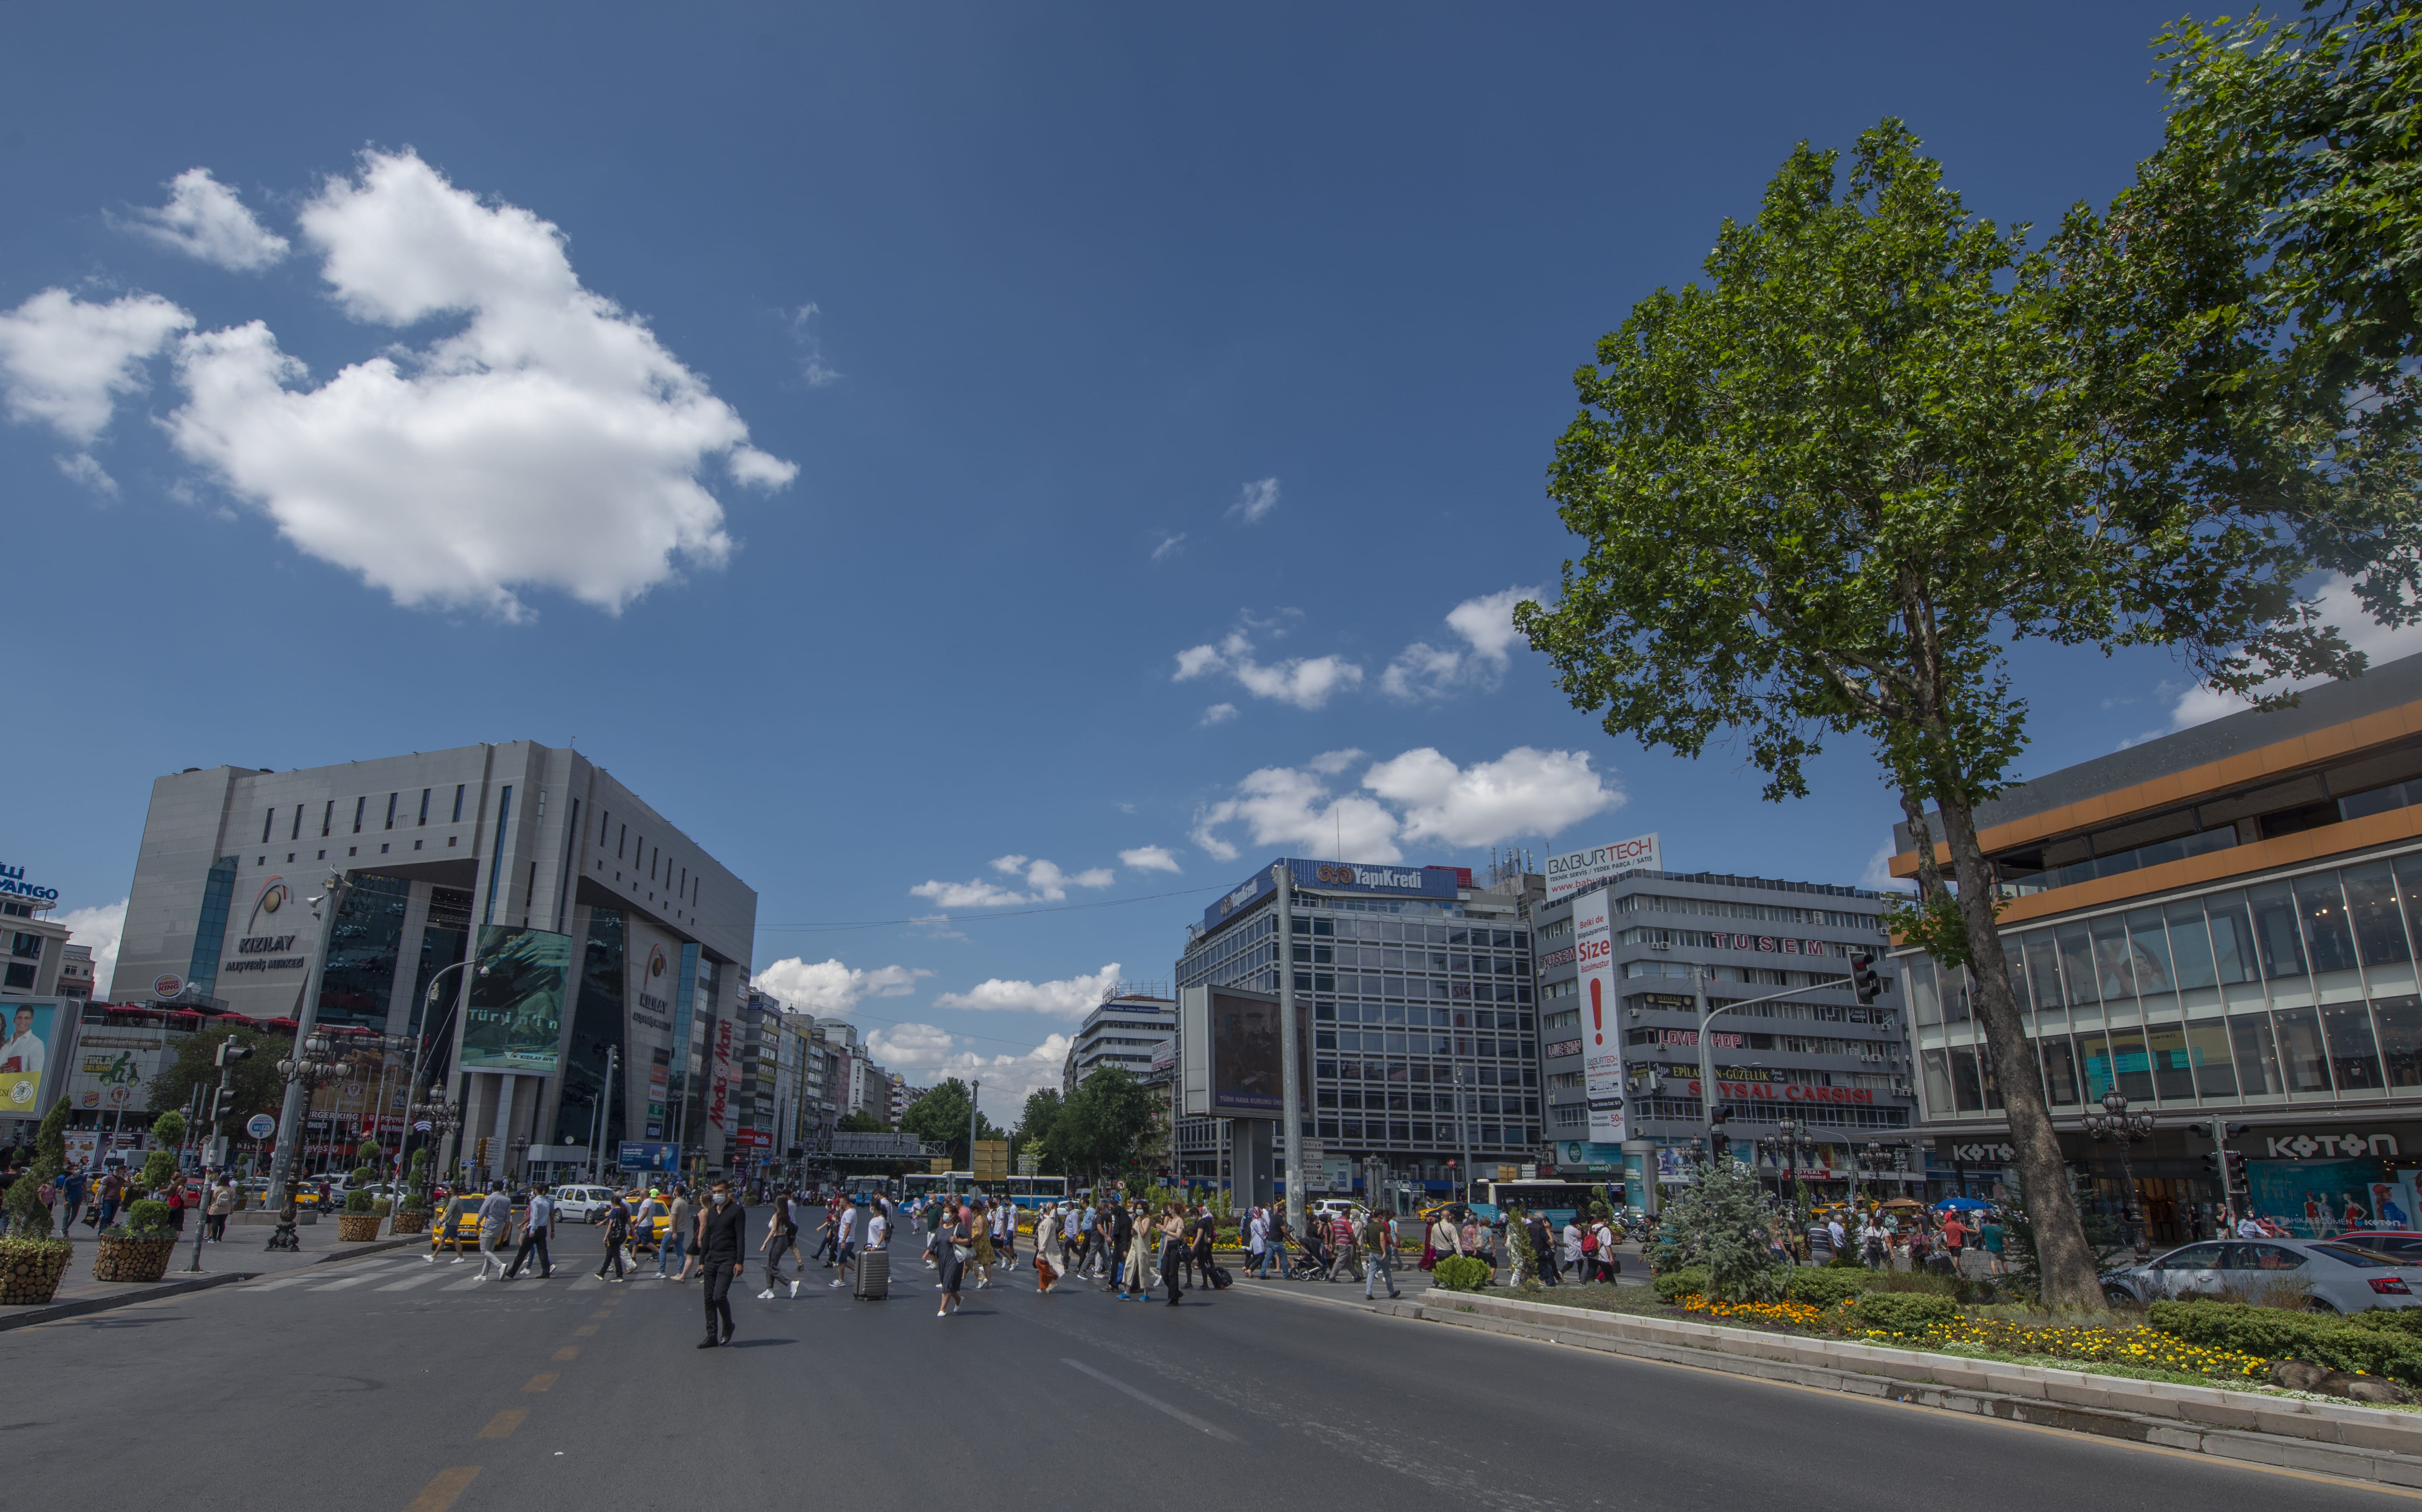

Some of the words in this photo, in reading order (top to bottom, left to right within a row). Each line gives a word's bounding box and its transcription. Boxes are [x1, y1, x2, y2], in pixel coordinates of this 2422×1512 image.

[1549, 837, 1652, 874] BABURTECH
[1353, 867, 1422, 889] YapıKredi
[1550, 873, 1569, 882] TEKNİK
[1570, 869, 1587, 878] SERVİS
[1637, 855, 1653, 864] SATIŞ
[1232, 879, 1257, 908] YapıKredi
[1578, 925, 1609, 940] Bilgisayarınız
[1580, 917, 1594, 929] Belki
[1595, 915, 1604, 924] de
[239, 935, 295, 953] KIZILAY
[1579, 940, 1610, 962] Size
[1712, 932, 1824, 956] TUSEM
[225, 959, 267, 973] ALIŞVERİŞ
[267, 956, 304, 969] MERKEZİ
[1540, 947, 1576, 969] TUSEM
[1581, 960, 1610, 973] Bozulmuştur
[158, 984, 179, 992] KING
[640, 993, 668, 1015] KIZILAY
[714, 1018, 732, 1066] Markt
[1547, 1043, 1564, 1058] LOVE
[1564, 1039, 1581, 1055] SHOP
[1659, 1029, 1699, 1047] LOVE
[1710, 1033, 1742, 1049] HOP
[1688, 1080, 1779, 1099] SYSAL
[709, 1077, 727, 1130] Media
[648, 1125, 661, 1136] mavi
